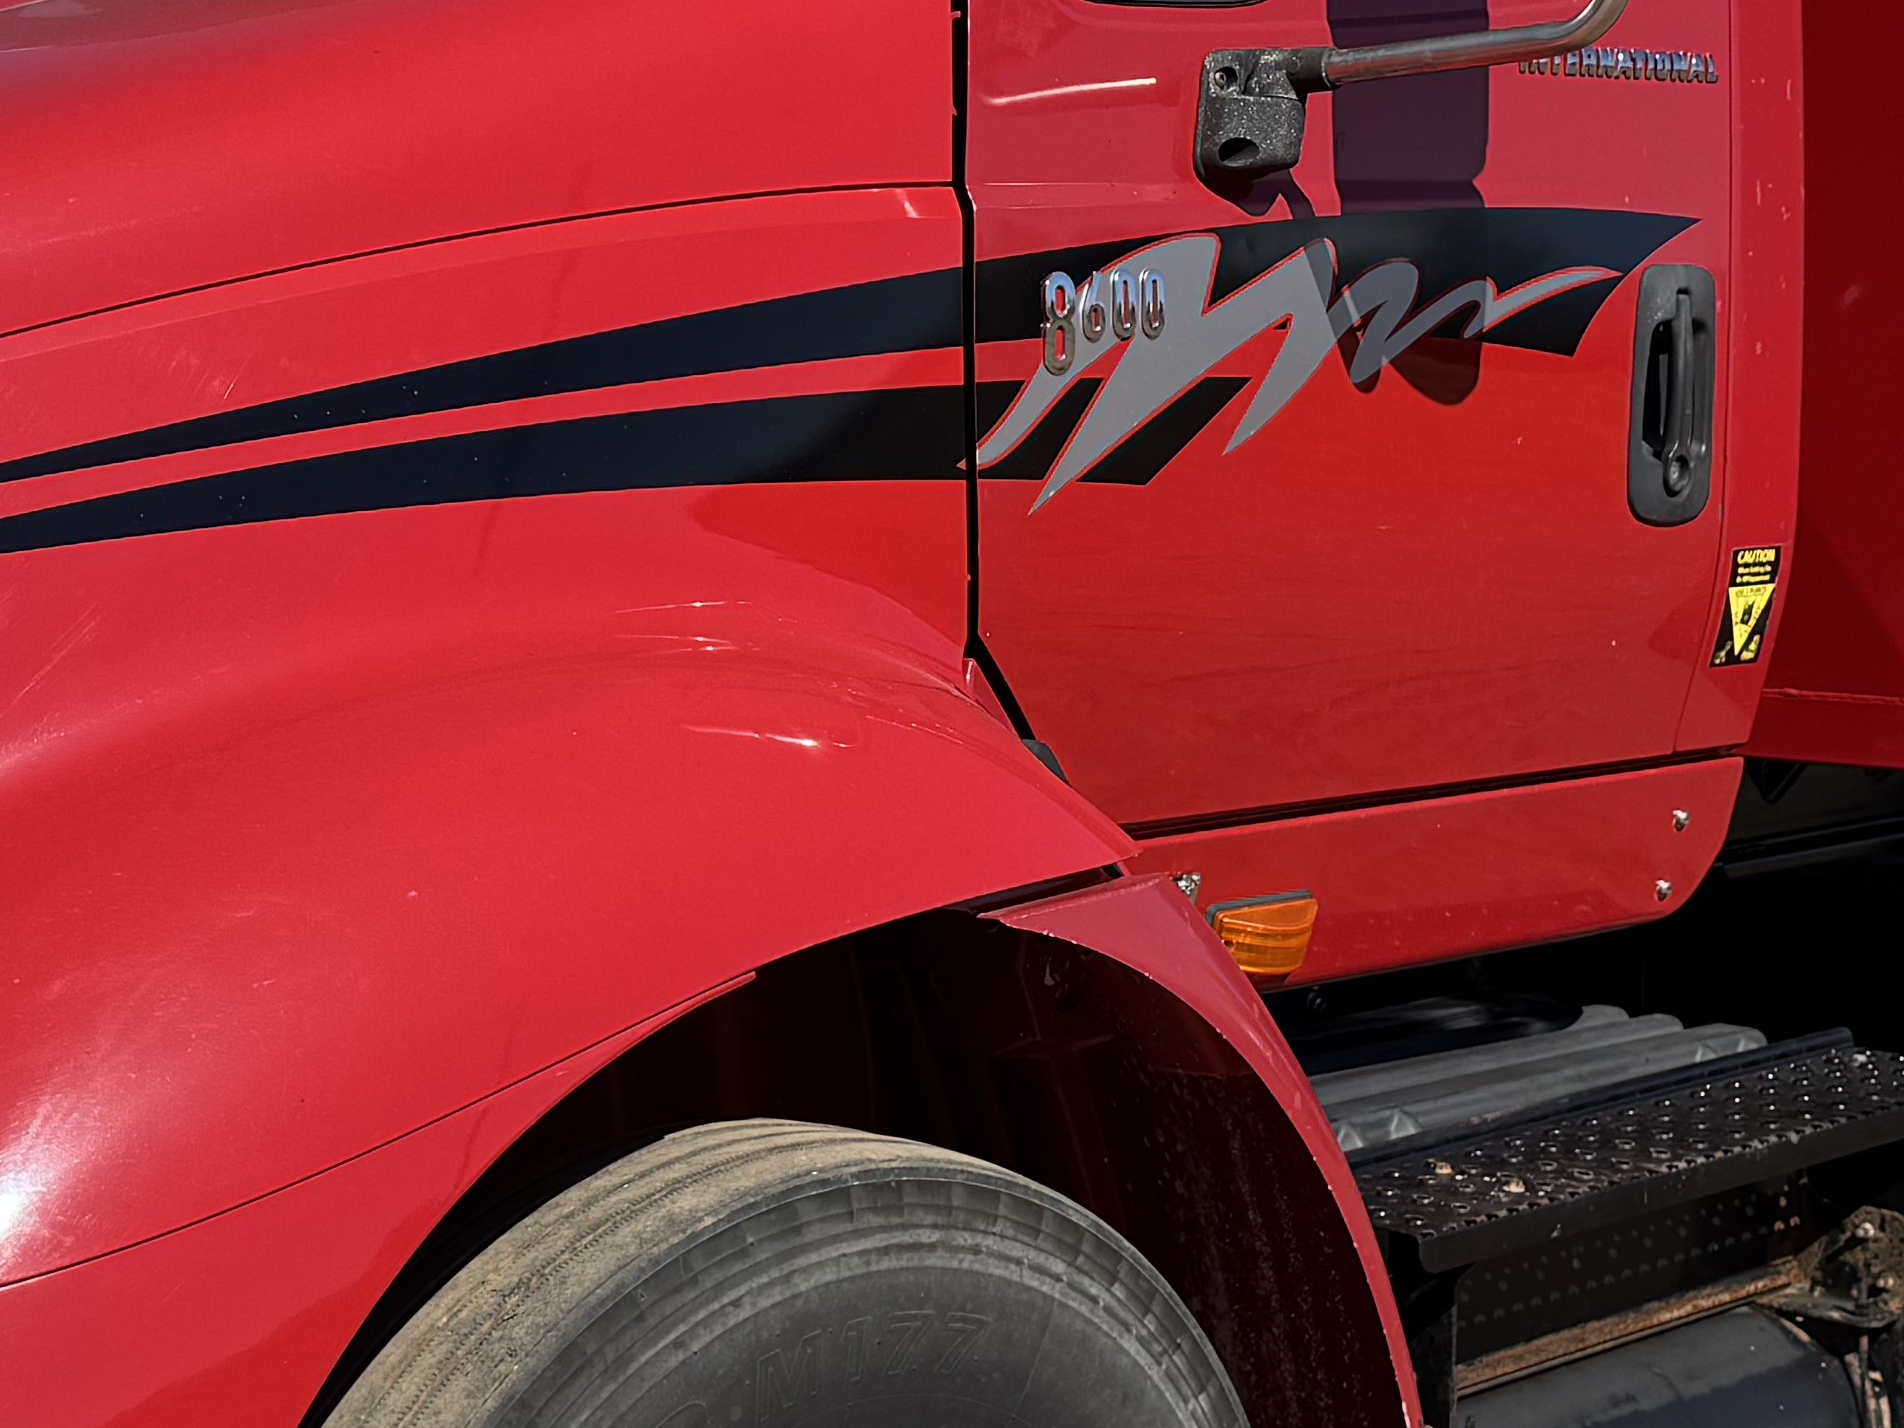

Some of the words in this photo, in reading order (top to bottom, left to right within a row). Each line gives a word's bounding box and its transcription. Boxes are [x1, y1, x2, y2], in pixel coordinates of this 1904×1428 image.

[1040, 270, 1166, 376] 8600
[1737, 548, 1775, 565] CAUTION
[753, 1310, 994, 1424] M177
